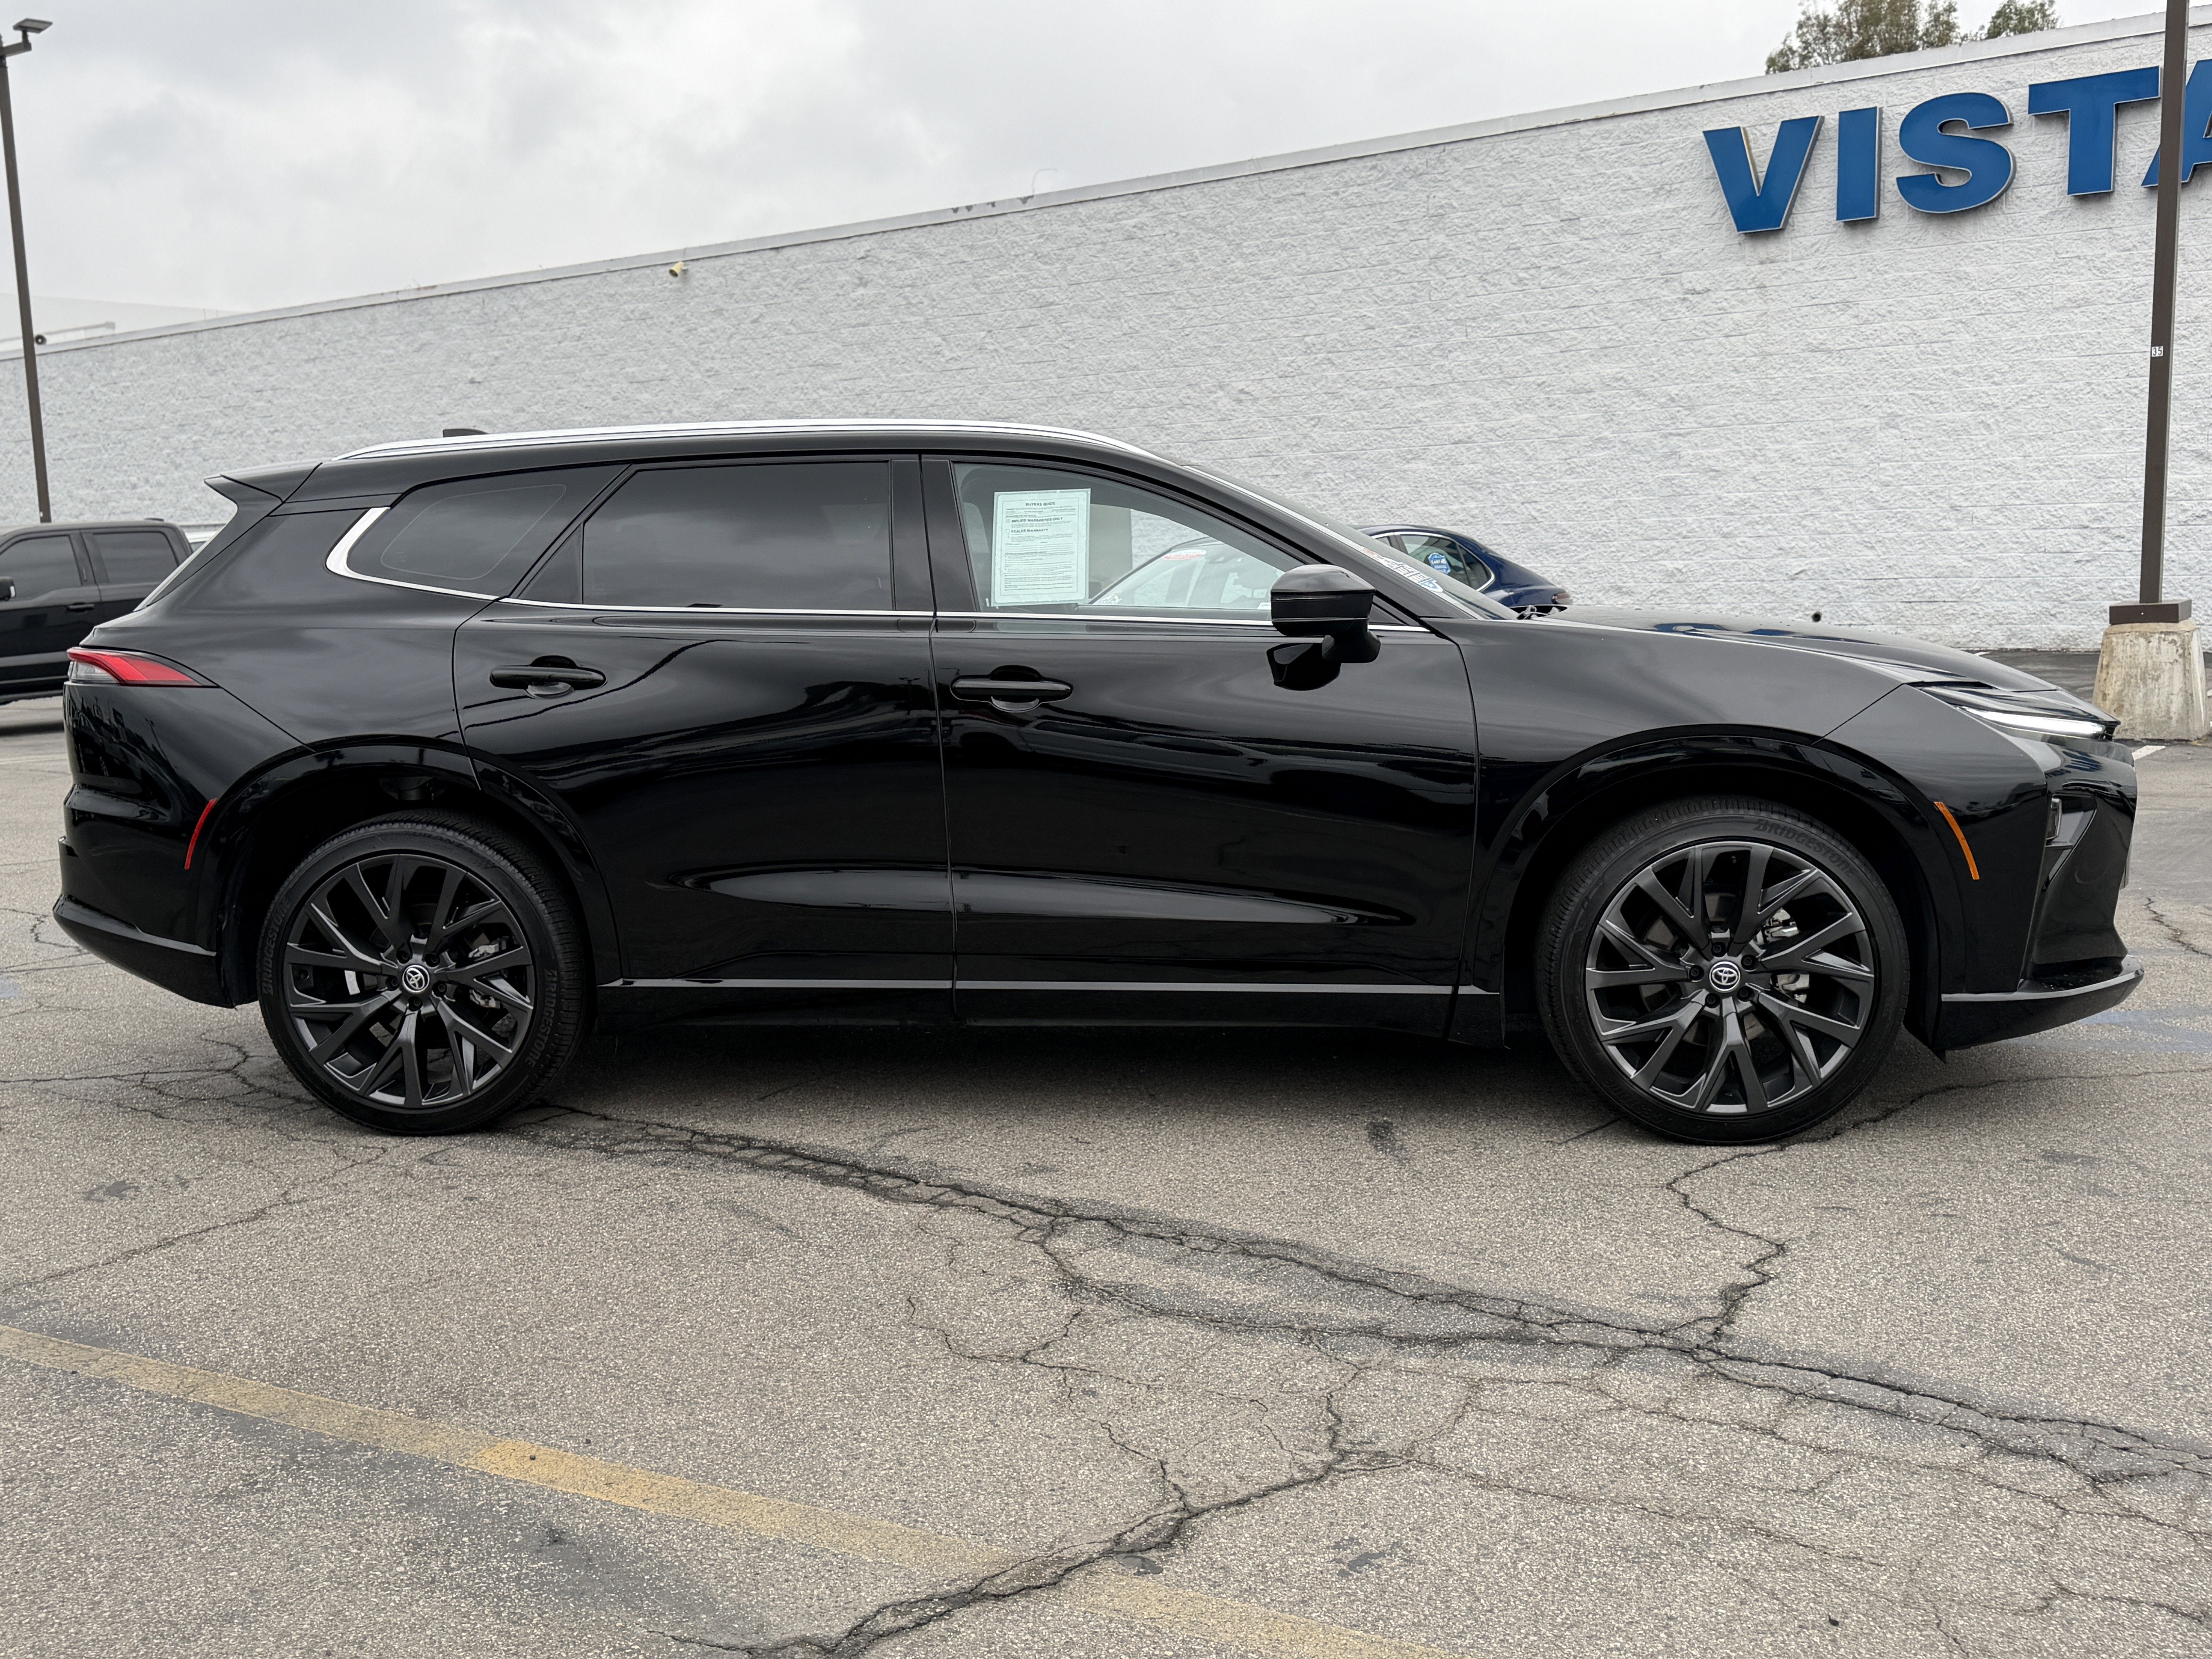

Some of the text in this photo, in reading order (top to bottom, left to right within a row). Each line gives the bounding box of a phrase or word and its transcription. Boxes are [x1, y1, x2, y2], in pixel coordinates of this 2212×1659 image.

[2153, 347, 2162, 356] 35
[1753, 818, 1859, 878] BRIDGESTONE
[261, 896, 291, 996] BRIDGESTONE
[525, 969, 558, 1068] BRIDGESTONE
